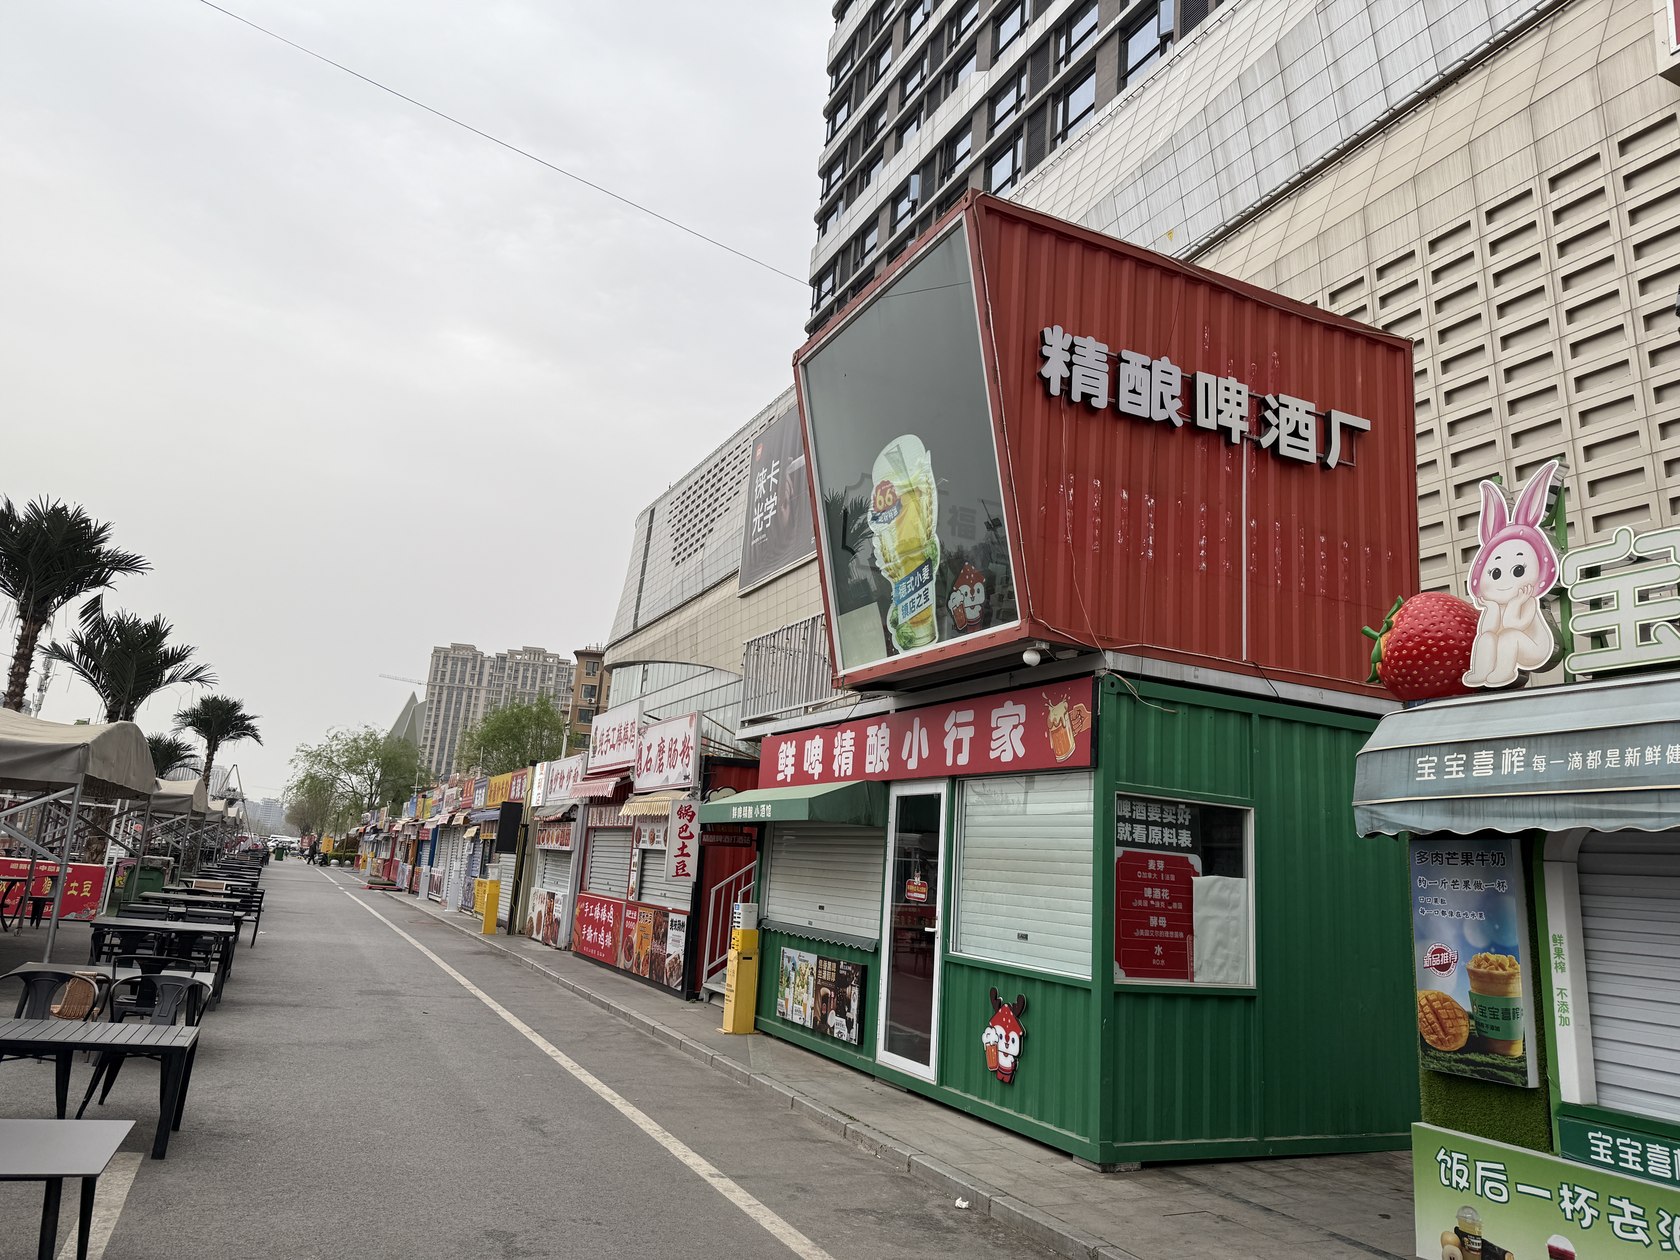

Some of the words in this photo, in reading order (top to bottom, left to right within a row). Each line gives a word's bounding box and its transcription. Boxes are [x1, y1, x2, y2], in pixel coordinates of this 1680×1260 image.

[1039, 325, 1371, 469] 精酿啤酒厂
[755, 460, 780, 503] 徕卡
[752, 492, 778, 537] 光学
[1560, 526, 1680, 676] 宝
[643, 731, 694, 775] 石磨肠粉
[776, 701, 1027, 783] 鲜啤精酿小行家
[1415, 747, 1527, 781] 宝宝喜榨
[1117, 800, 1192, 826] 啤酒要买好
[672, 804, 696, 877] 锅巴土豆
[1117, 822, 1192, 848] 就看原料表
[1148, 859, 1165, 872] 麦芽
[1415, 850, 1507, 867] 多肉芒果牛奶
[1143, 887, 1170, 900] 啤酒花
[1417, 876, 1508, 893] 约一斤芒果做一杯
[1419, 896, 1447, 905] 口口果粒
[1419, 907, 1486, 920] 每一口都像在吃水果
[583, 902, 614, 927] 手工棒棒鸡
[1149, 916, 1167, 928] 酵母
[1154, 944, 1163, 956] 水
[1423, 950, 1458, 969] 新品推荐
[1551, 933, 1566, 974] 鲜果榨
[1478, 1004, 1520, 1021] 宝宝喜榨
[1556, 987, 1570, 1027] 不添加
